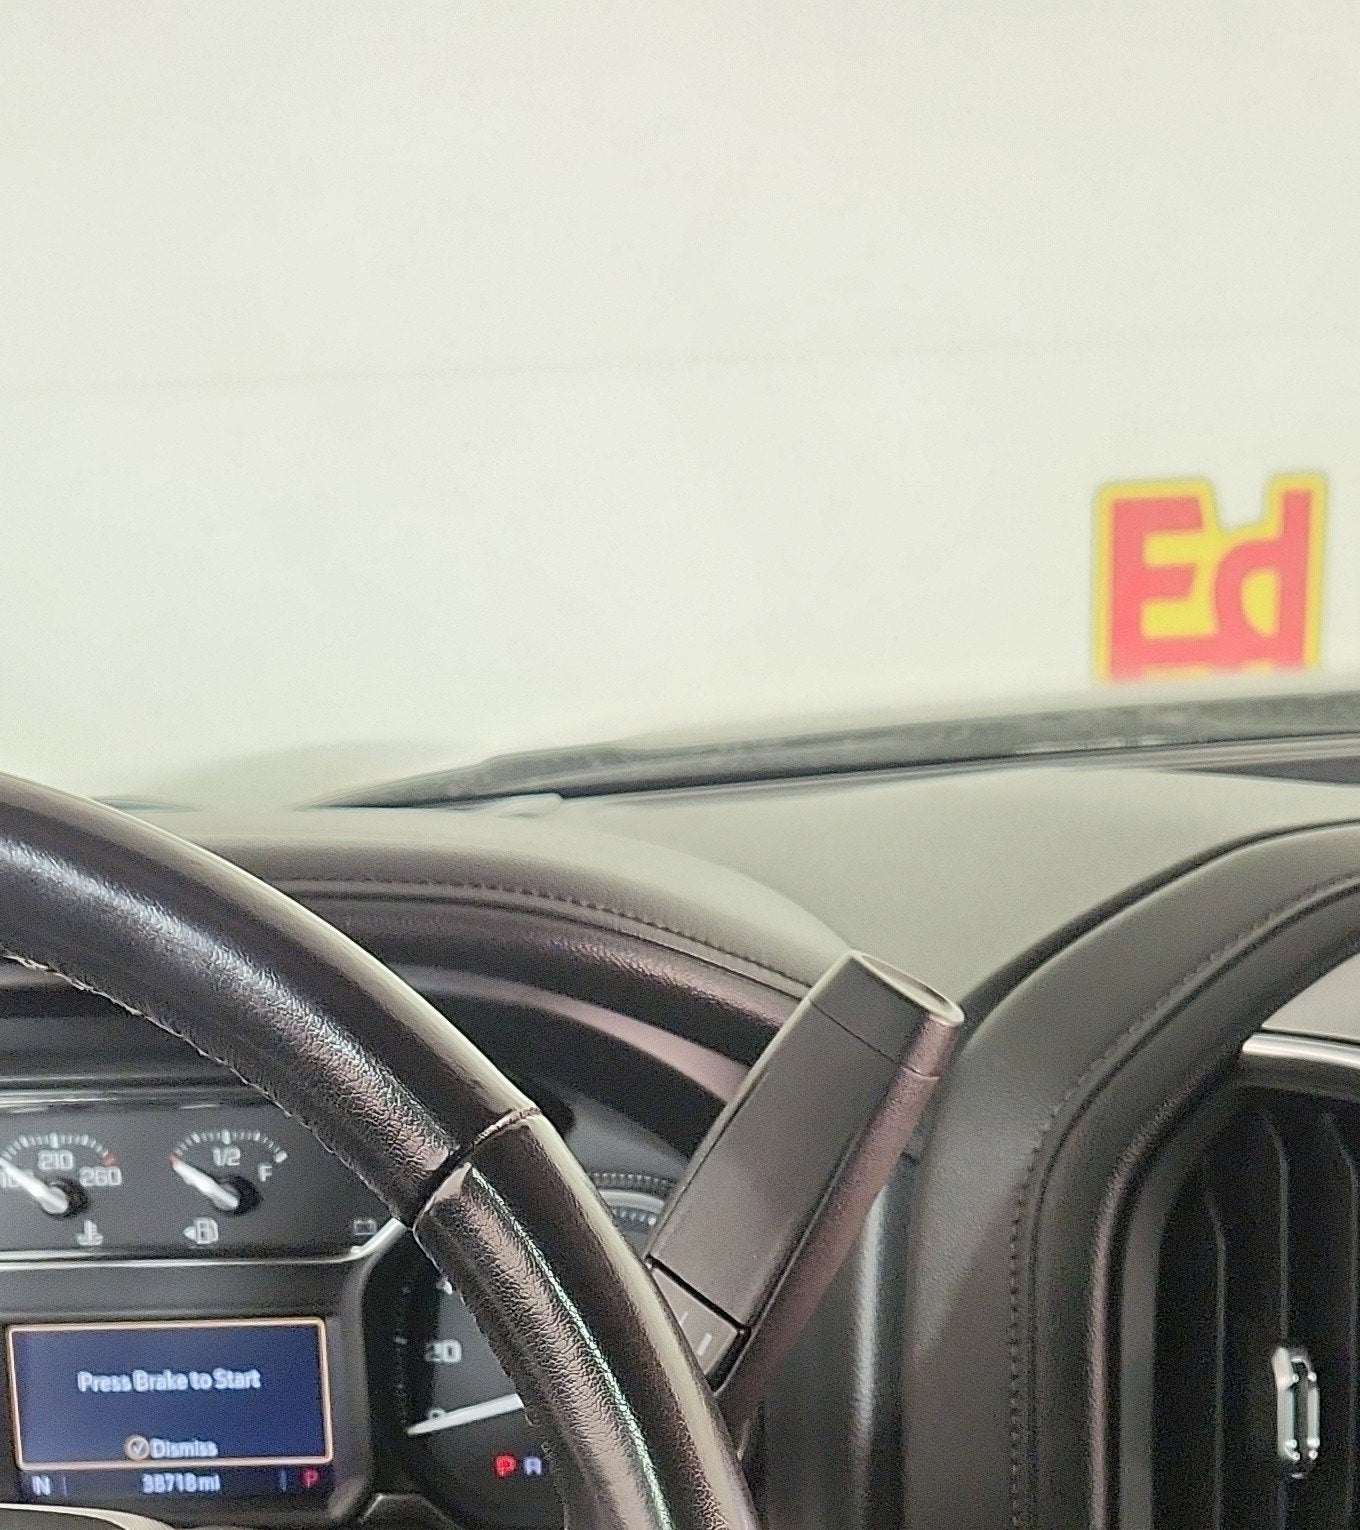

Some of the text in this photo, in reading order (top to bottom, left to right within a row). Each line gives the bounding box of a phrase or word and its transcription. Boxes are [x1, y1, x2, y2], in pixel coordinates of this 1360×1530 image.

[1095, 474, 1327, 684] Ed
[38, 1151, 74, 1172] 210
[79, 1166, 122, 1187] 260
[257, 1163, 273, 1182] F
[77, 1367, 261, 1392] Press Brake to Start
[150, 1437, 218, 1459] Dismiss
[496, 1455, 517, 1477] P
[31, 1475, 52, 1496] N
[302, 1468, 320, 1489] P
